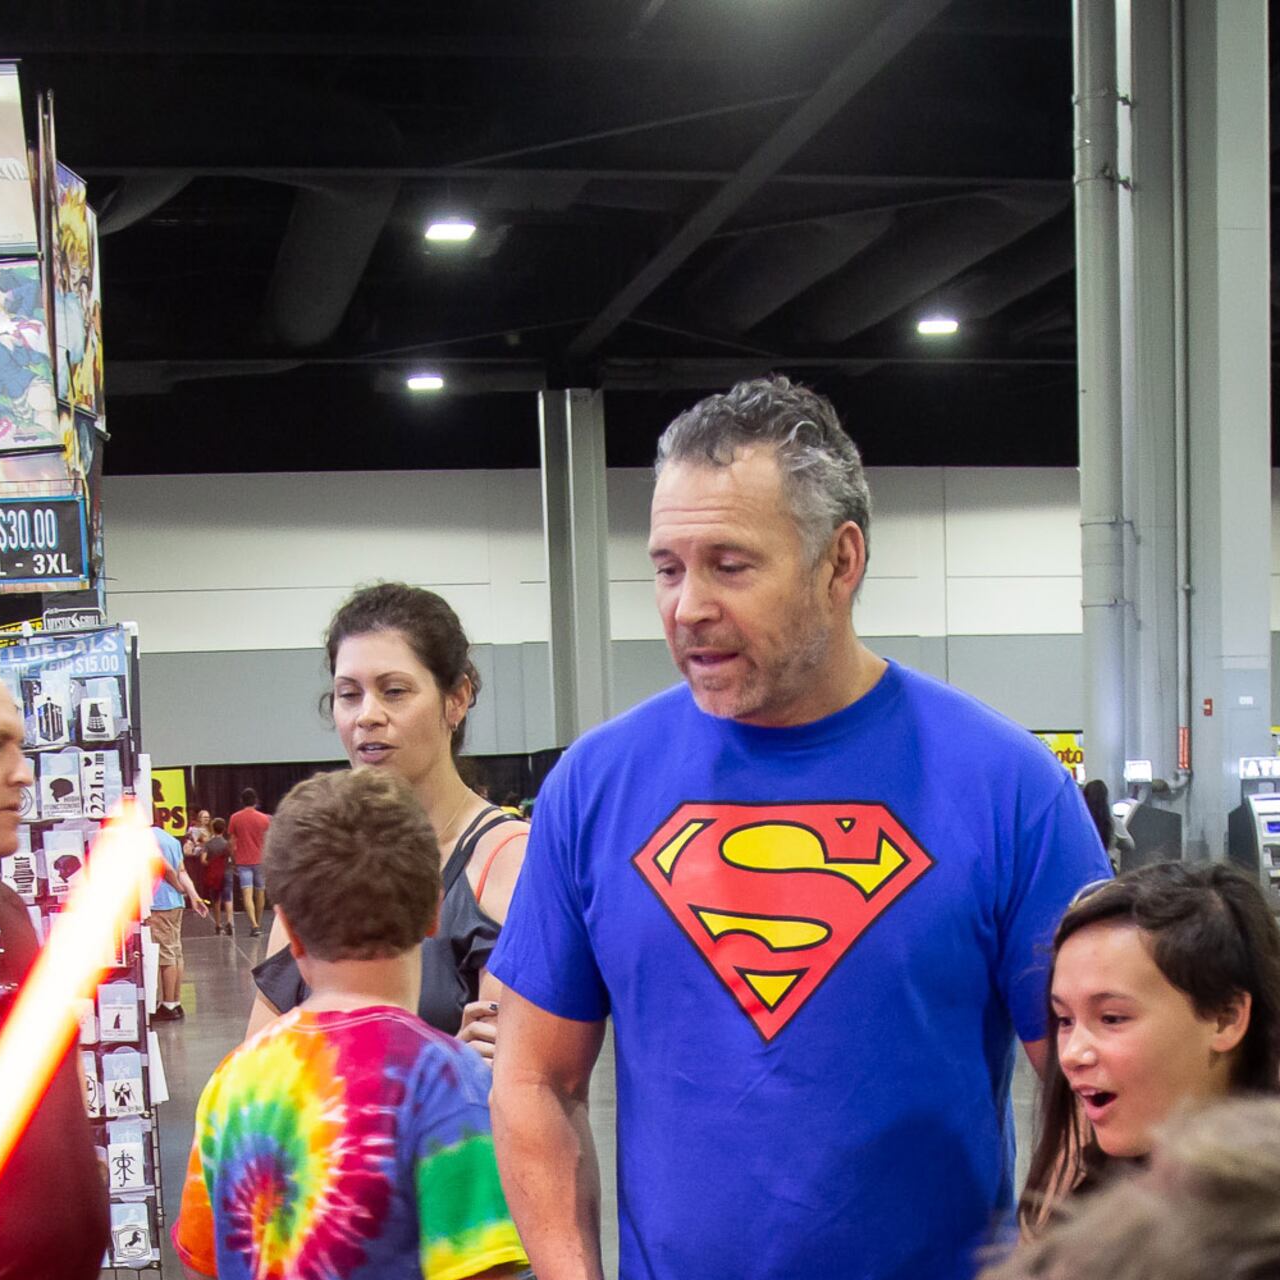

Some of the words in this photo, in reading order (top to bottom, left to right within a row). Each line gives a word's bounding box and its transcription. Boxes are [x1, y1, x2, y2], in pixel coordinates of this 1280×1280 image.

[33, 553, 73, 575] 3XL
[29, 633, 118, 662] DECALS
[75, 654, 120, 674] $15.00
